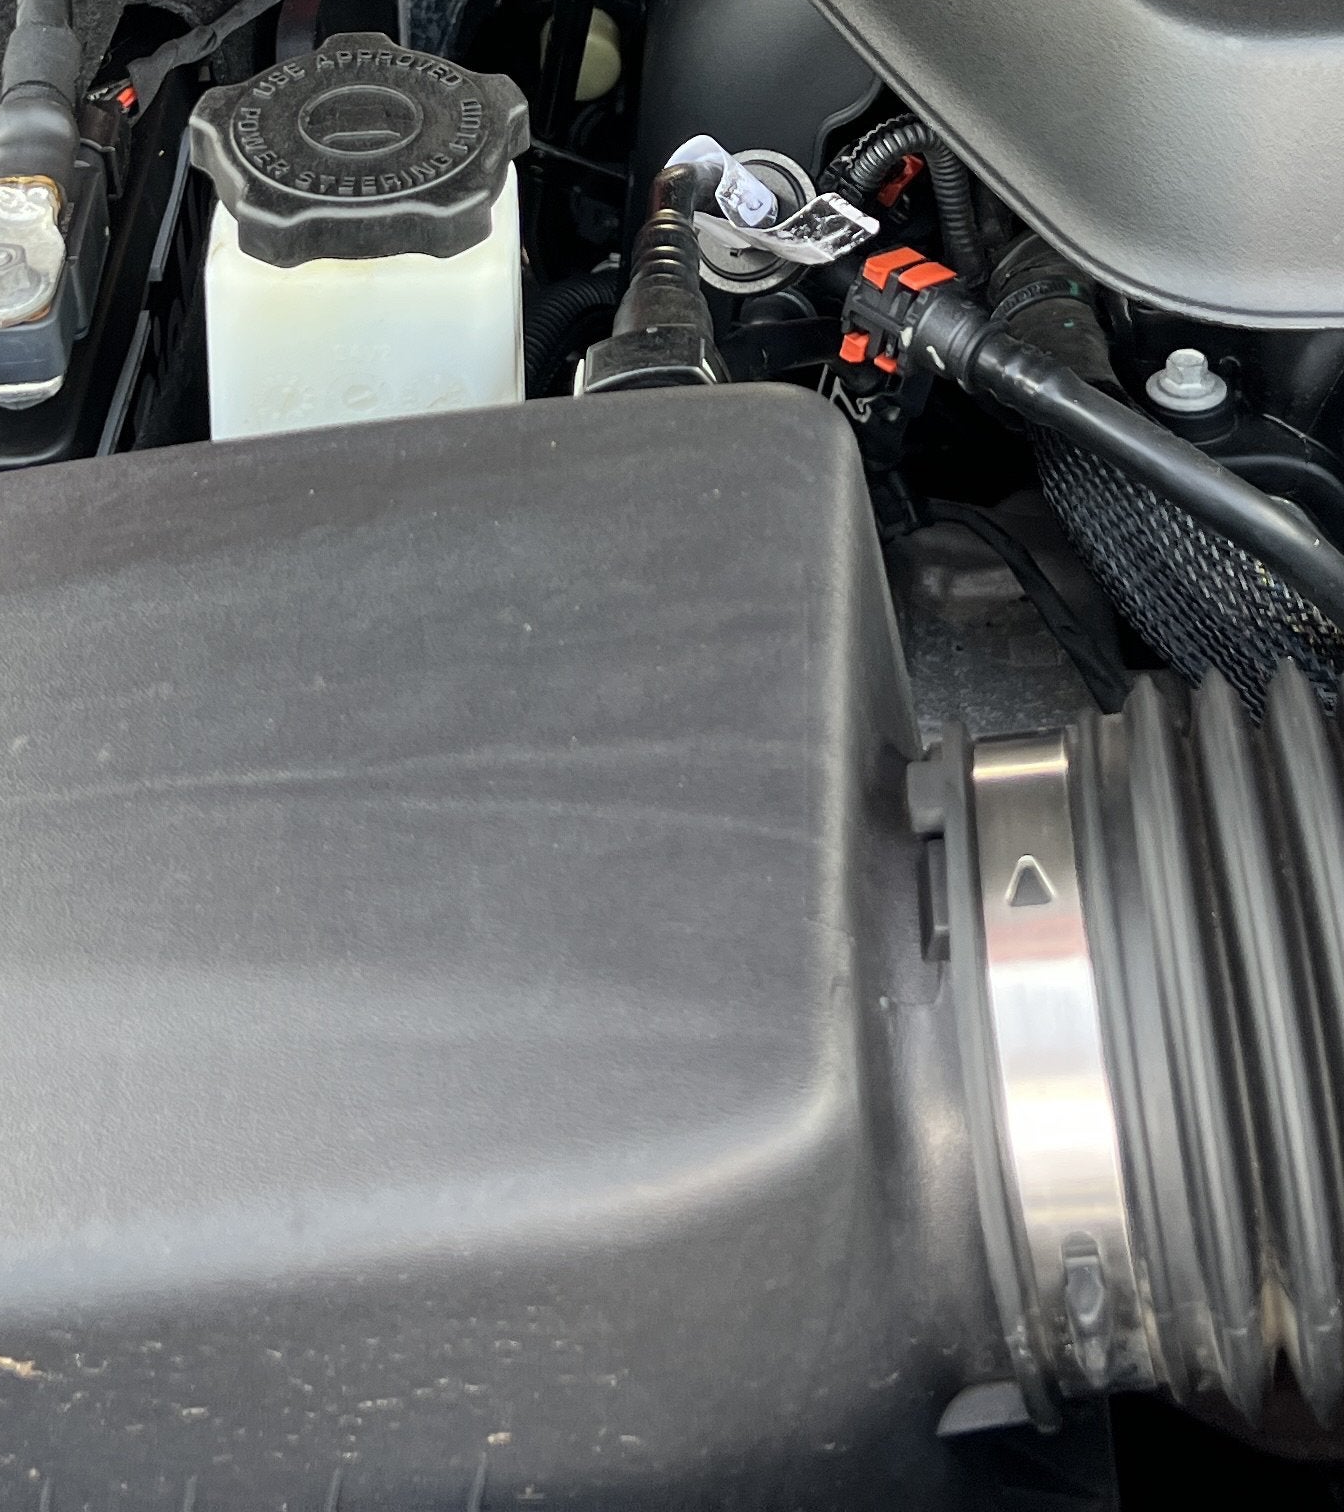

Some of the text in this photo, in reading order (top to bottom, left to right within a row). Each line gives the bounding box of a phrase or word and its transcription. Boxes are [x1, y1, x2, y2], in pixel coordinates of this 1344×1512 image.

[253, 48, 465, 100] USE APPROVED
[237, 97, 484, 196] POWER STEERING FLUID
